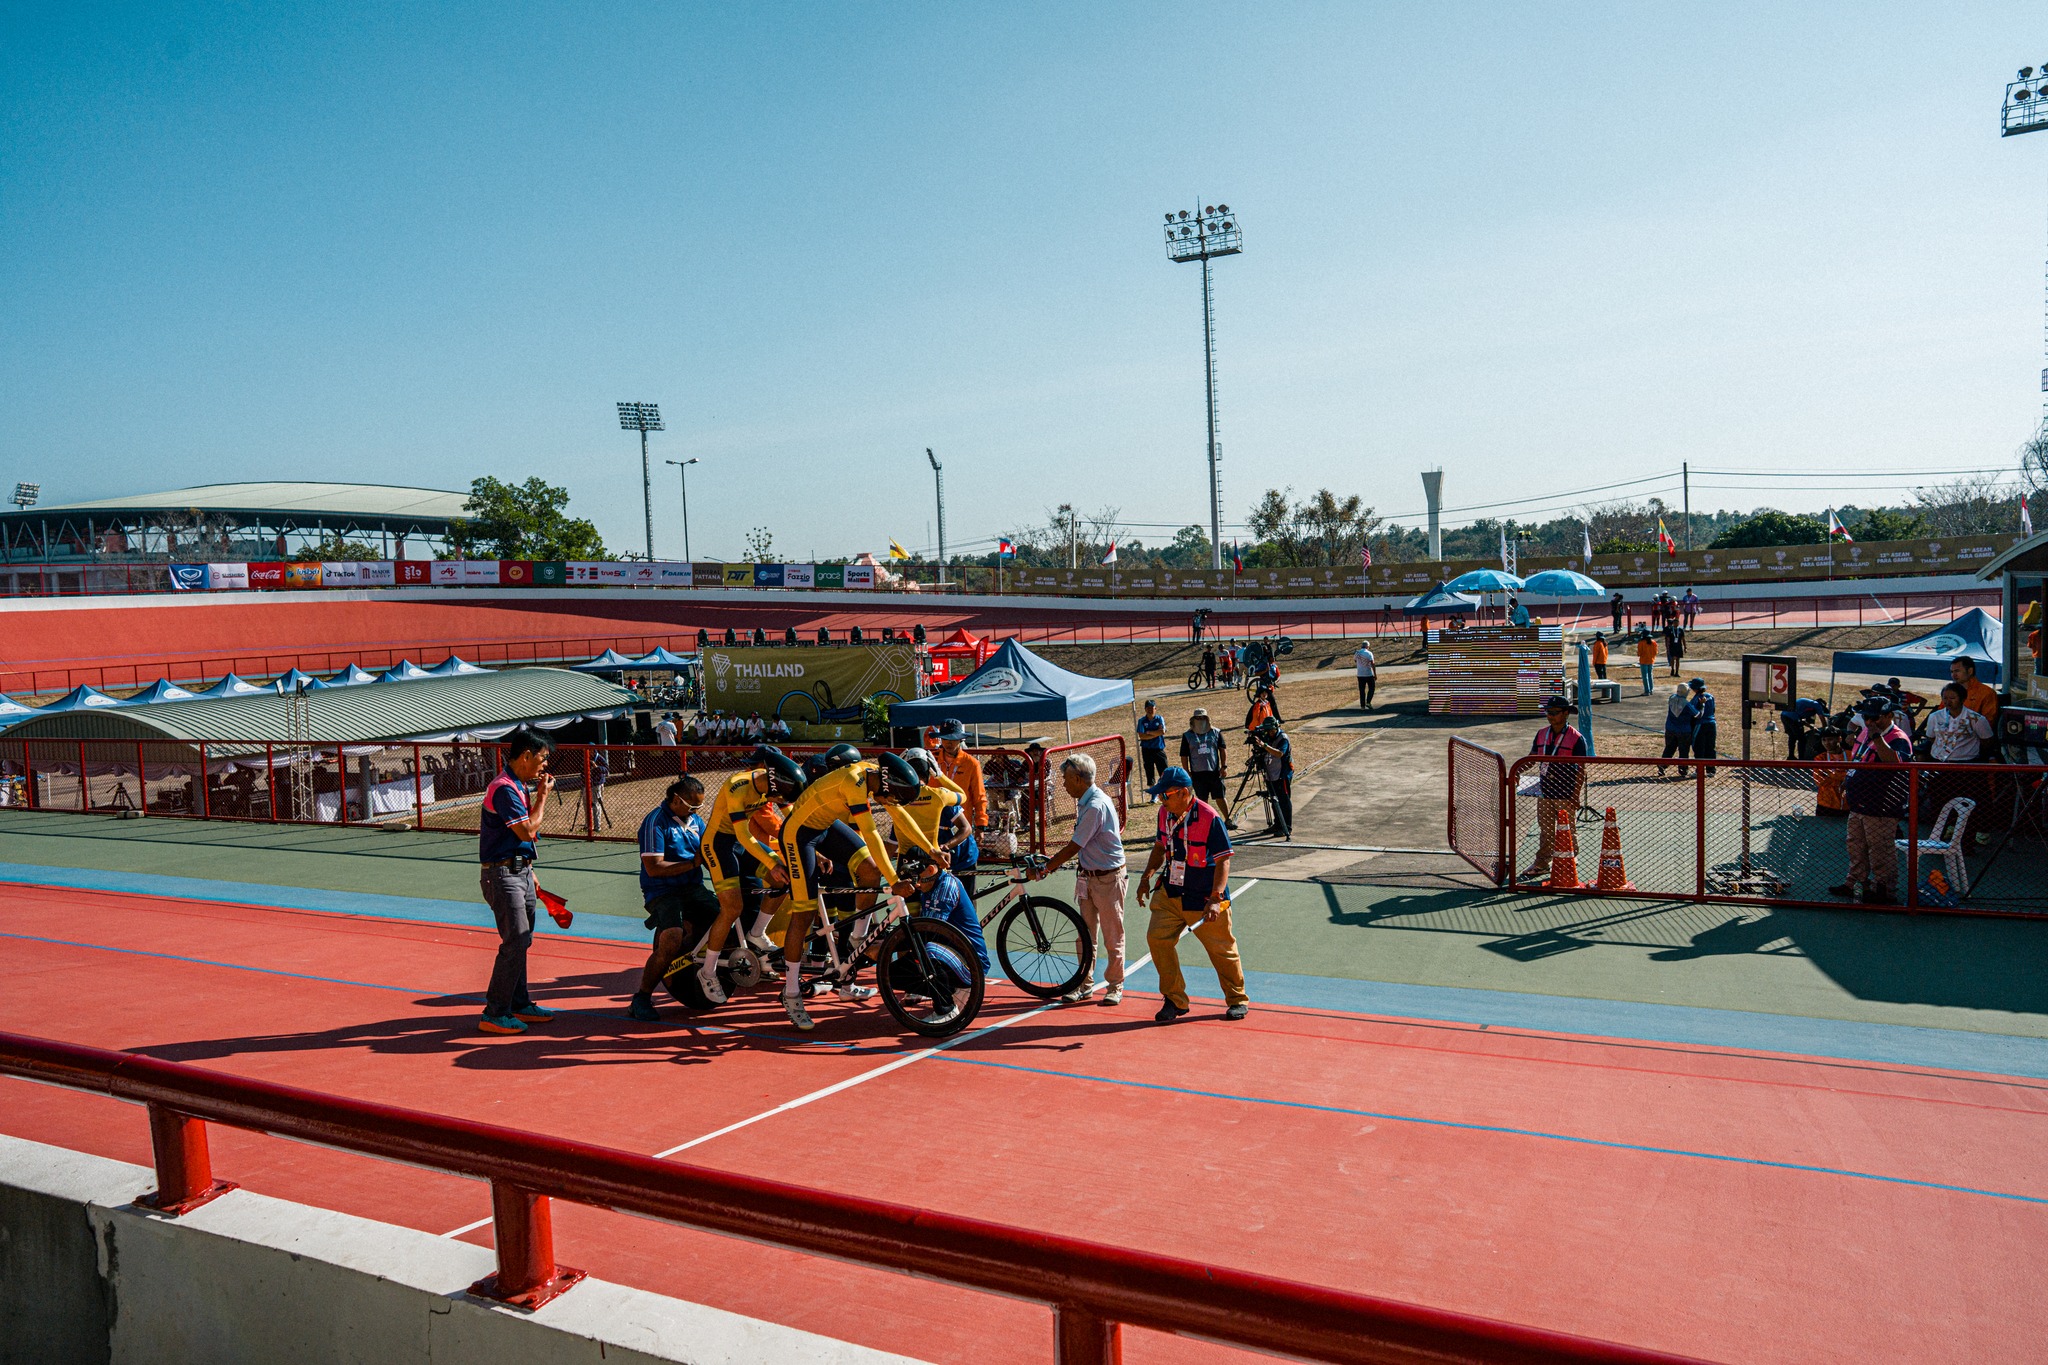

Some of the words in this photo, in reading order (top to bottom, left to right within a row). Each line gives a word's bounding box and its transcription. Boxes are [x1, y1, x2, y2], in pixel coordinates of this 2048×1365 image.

[251, 569, 281, 580] Coca-Cola
[734, 664, 805, 677] THAILAND
[736, 679, 761, 689] 2025
[1773, 664, 1787, 693] 3
[835, 727, 842, 737] 3
[730, 780, 749, 793] THAILAND
[768, 767, 777, 792] KASK
[703, 843, 716, 868] THAILAND
[787, 842, 800, 879] THAILAND
[981, 895, 1012, 927] atrix
[668, 958, 685, 972] AVIC
